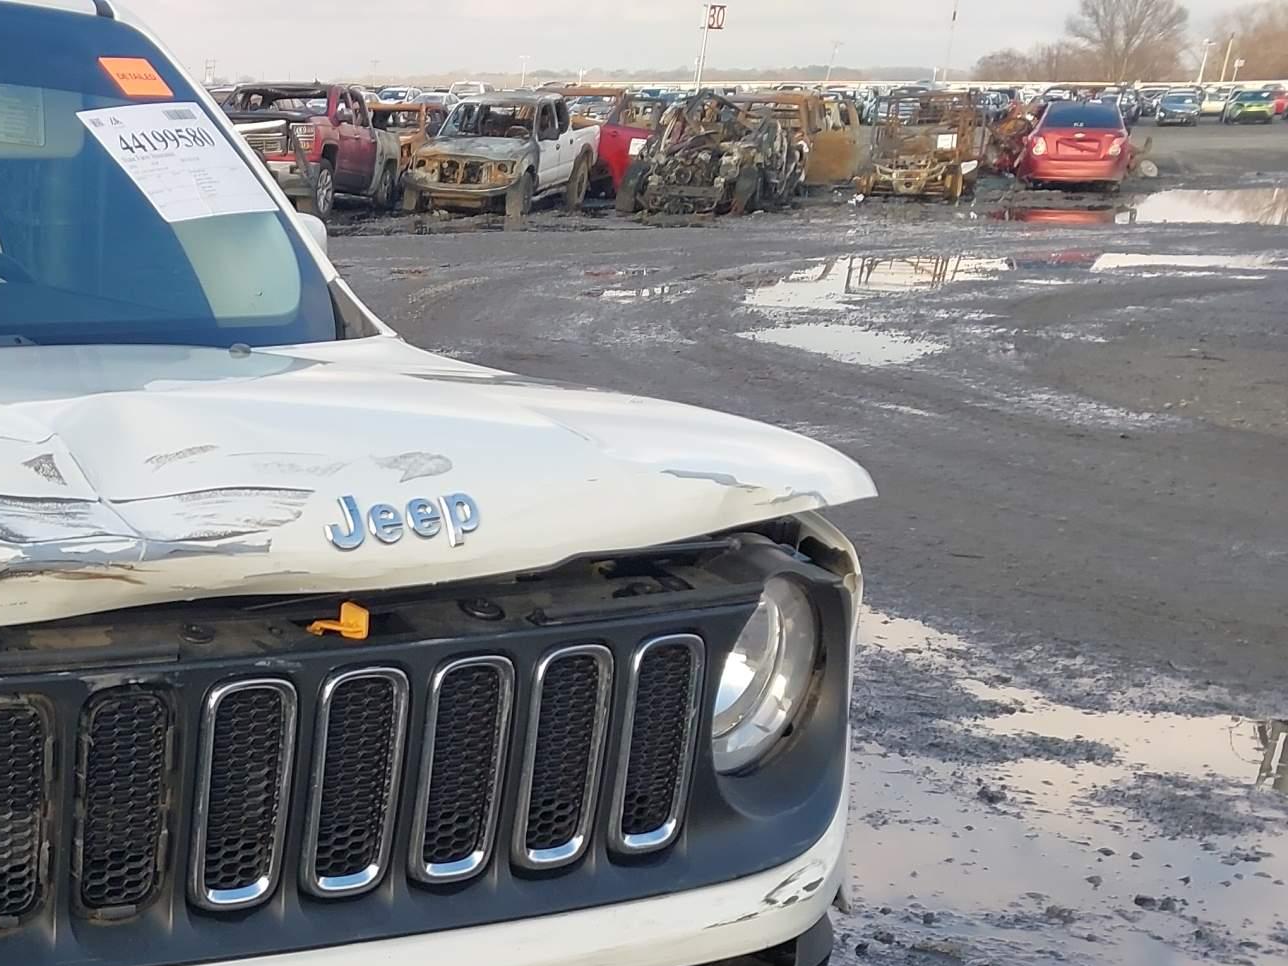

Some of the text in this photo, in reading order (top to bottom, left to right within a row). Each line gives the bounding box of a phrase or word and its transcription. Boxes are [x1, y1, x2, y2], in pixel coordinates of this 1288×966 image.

[709, 5, 725, 28] 30
[119, 126, 215, 154] 44199580
[323, 491, 480, 550] Jeep
